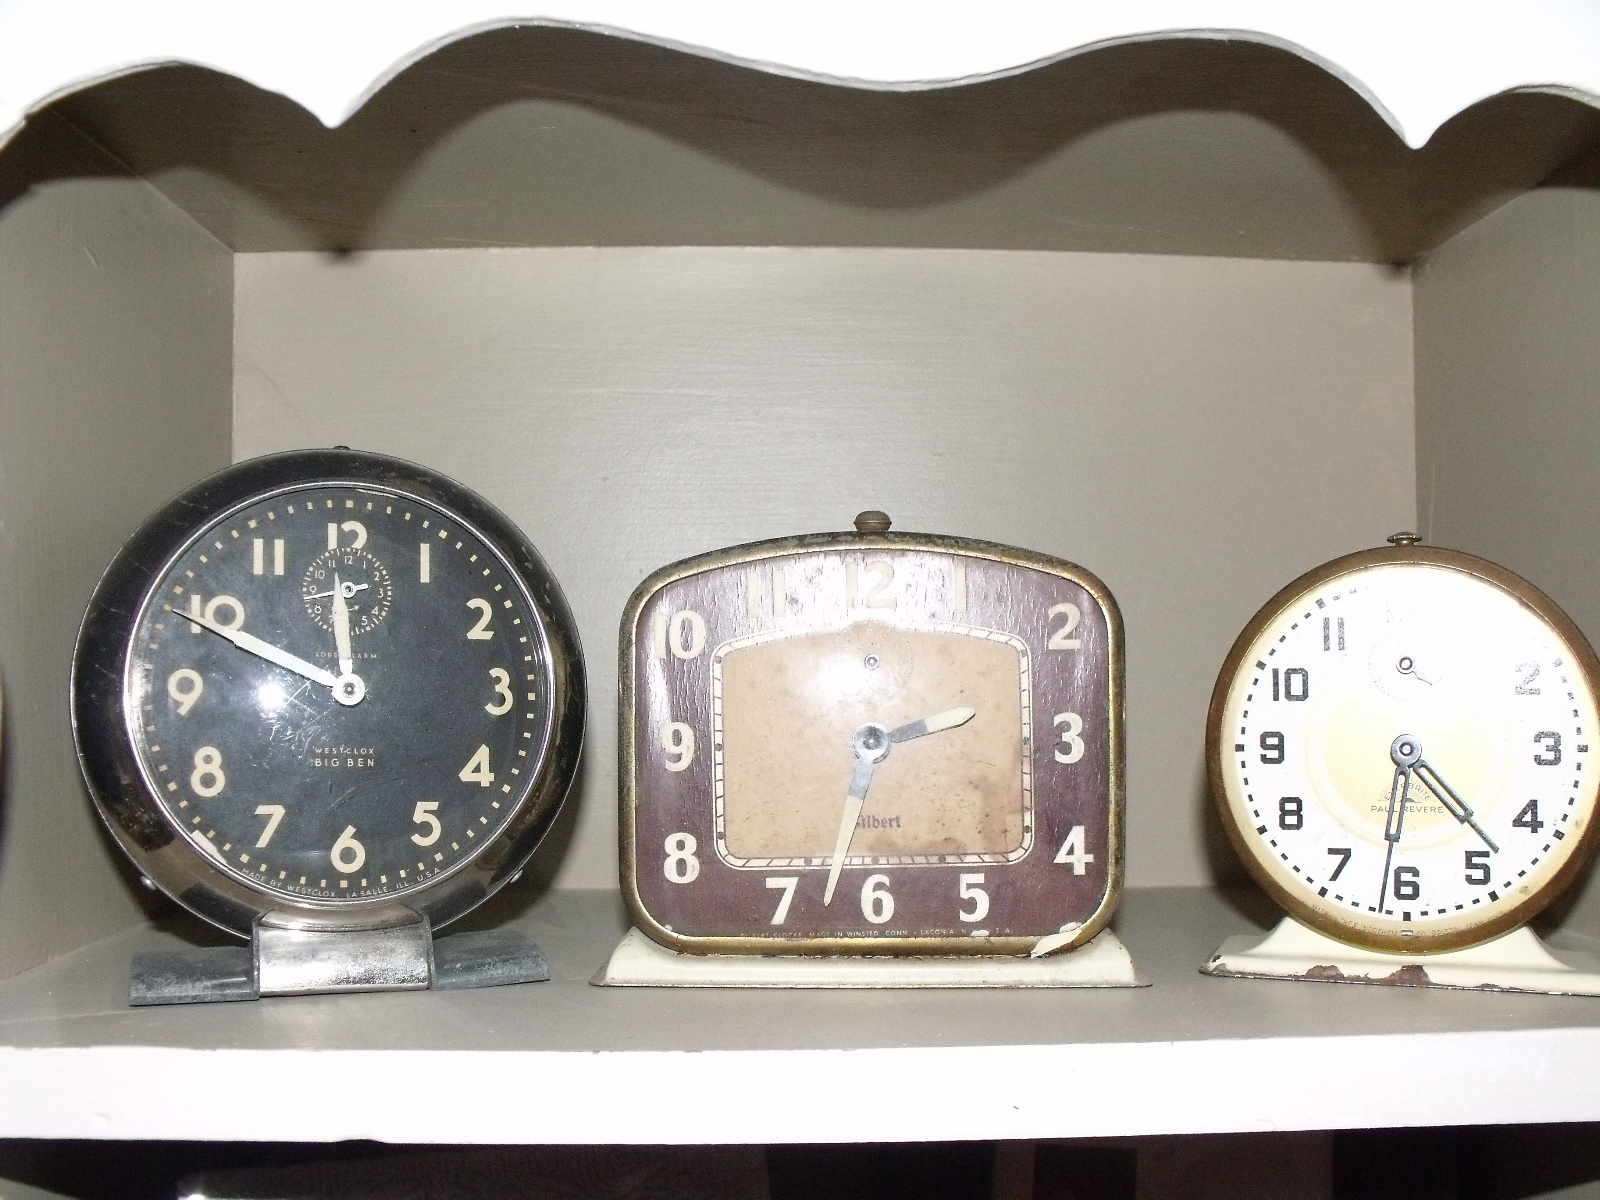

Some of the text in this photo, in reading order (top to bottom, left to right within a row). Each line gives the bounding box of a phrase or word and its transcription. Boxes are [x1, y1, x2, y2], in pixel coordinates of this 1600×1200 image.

[328, 520, 368, 550] 12
[253, 538, 285, 576] 11
[314, 570, 326, 580] 10
[328, 559, 336, 568] 11
[344, 555, 353, 565] 12
[420, 543, 430, 583] 1
[309, 585, 317, 595] 9
[373, 571, 380, 581] 2
[377, 588, 384, 598] 3
[746, 569, 787, 618] 11
[846, 559, 897, 611] 12
[954, 561, 968, 614] 1
[190, 594, 245, 634] 10
[361, 615, 368, 626] 5
[371, 606, 379, 615] 4
[466, 598, 494, 640] 2
[1048, 602, 1081, 650] 2
[653, 608, 706, 660] 10
[1323, 617, 1345, 652] 11
[167, 668, 204, 716] 9
[484, 667, 514, 716] 3
[1271, 667, 1309, 702] 10
[1514, 659, 1542, 696] 2
[314, 747, 374, 755] WESTCLOX
[661, 721, 695, 772] 9
[1053, 711, 1085, 764] 3
[1259, 730, 1285, 765] 9
[1533, 730, 1562, 766] 3
[190, 746, 226, 798] 8
[315, 758, 374, 767] BIG BEN
[458, 743, 495, 787] 4
[254, 803, 286, 848] 7
[410, 801, 442, 847] 5
[855, 814, 902, 829] ilbert
[1278, 796, 1303, 831] 8
[1512, 798, 1544, 834] 4
[330, 824, 366, 874] 6
[663, 832, 700, 885] 8
[1053, 825, 1094, 877] 4
[1327, 847, 1352, 882] 7
[241, 867, 267, 888] MADE
[269, 879, 283, 889] BY
[1393, 865, 1420, 901] 6
[1464, 850, 1491, 886] 5
[765, 876, 800, 926] 7
[860, 873, 895, 925] 6
[958, 873, 990, 923] 5
